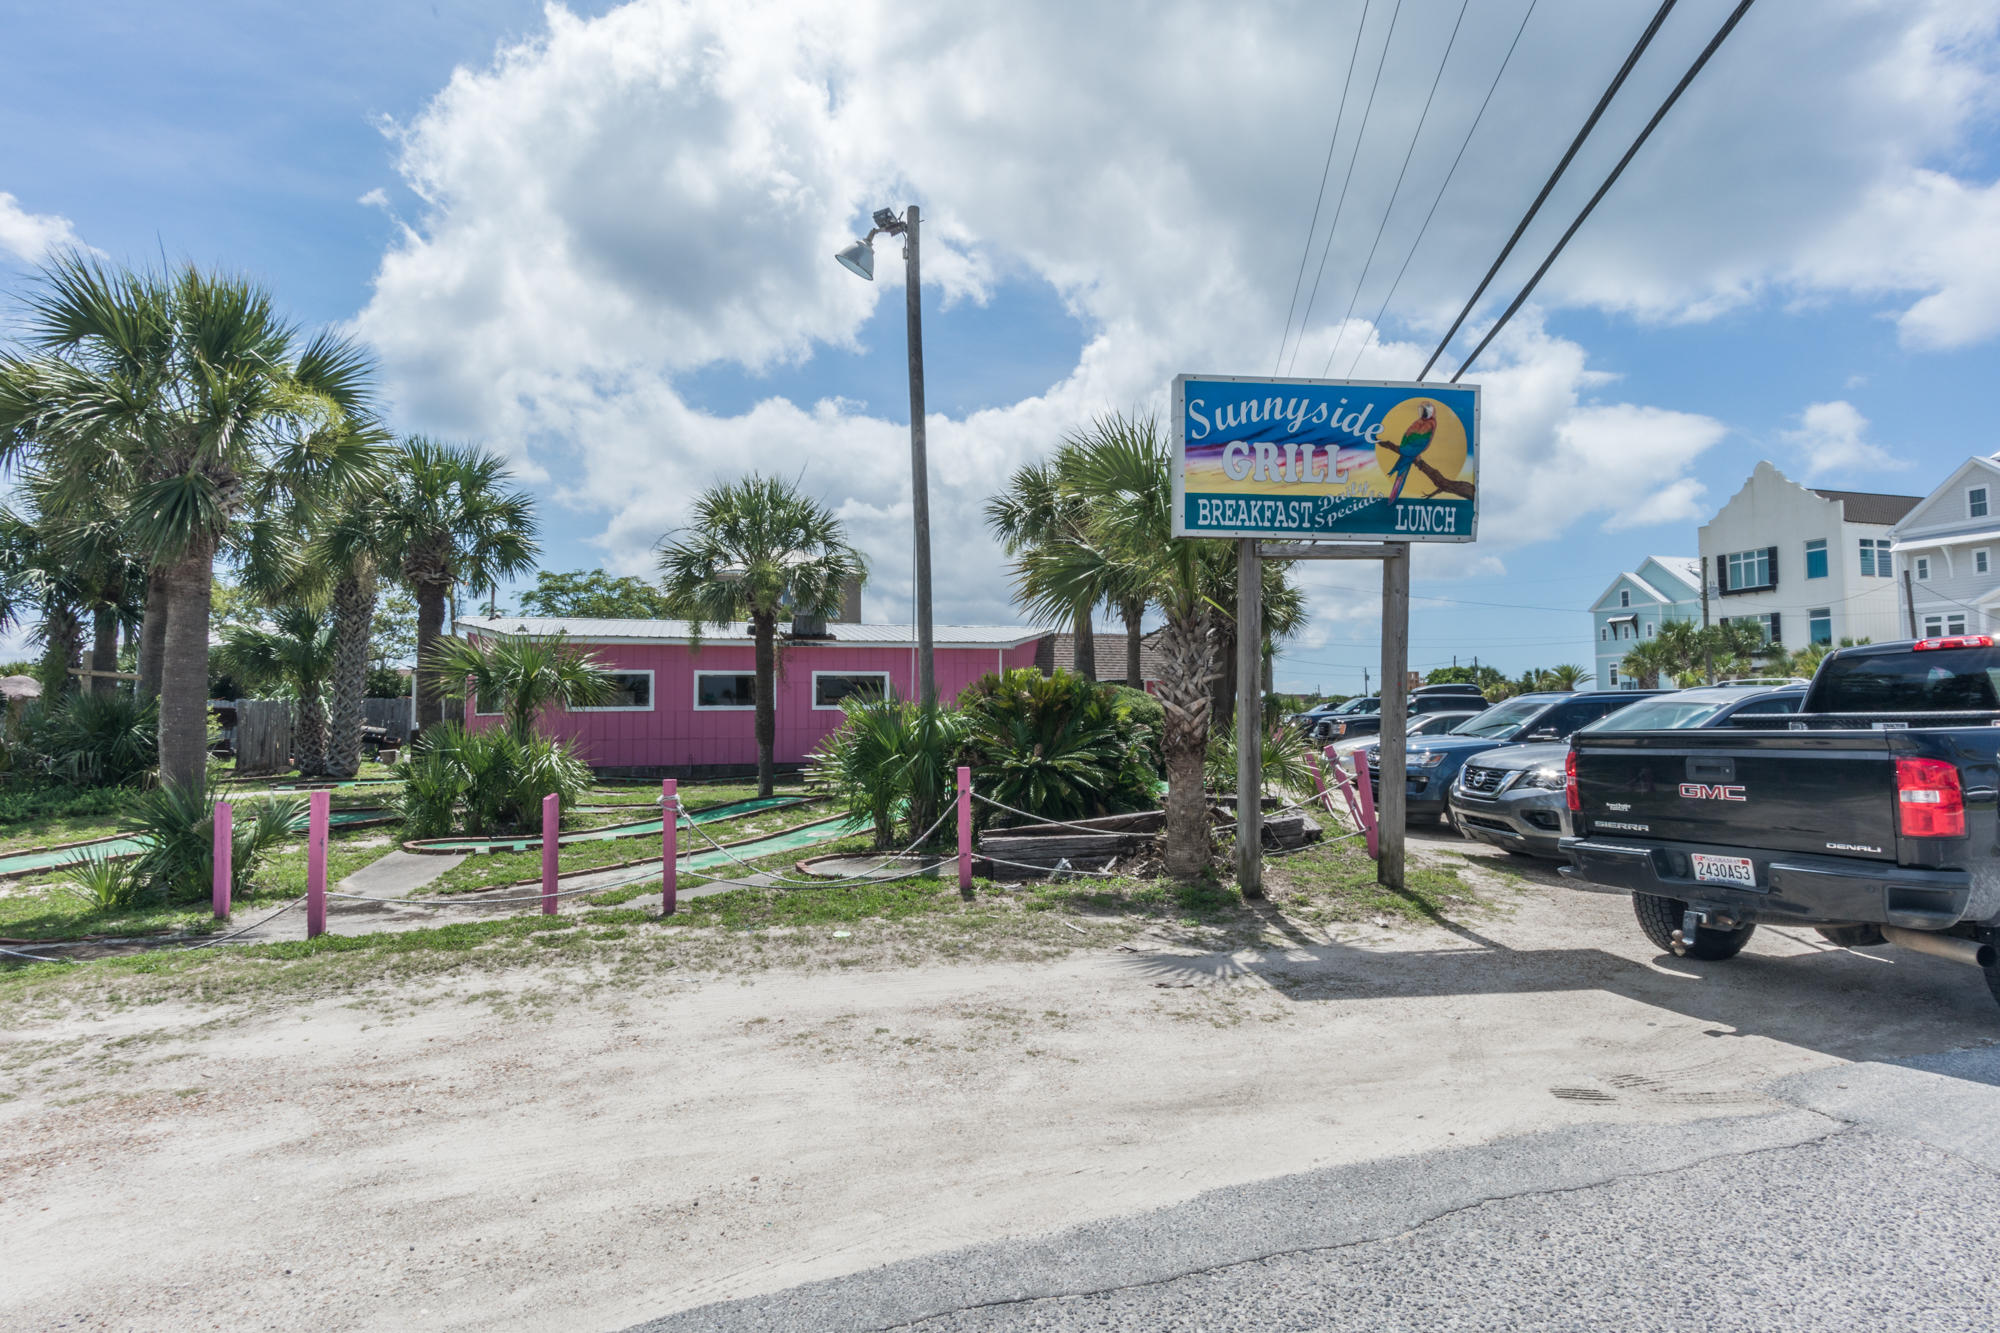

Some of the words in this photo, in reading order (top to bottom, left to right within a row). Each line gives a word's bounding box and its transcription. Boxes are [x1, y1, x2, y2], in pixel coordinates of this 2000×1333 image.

[1189, 397, 1385, 444] Sunnyside
[1222, 440, 1349, 484] GRILL
[1314, 490, 1384, 528] Specials
[1318, 481, 1369, 511] Daily
[1198, 498, 1313, 528] BREAKFAST
[1394, 504, 1456, 532] LUNCH
[1679, 783, 1746, 801] GMC
[1594, 820, 1649, 831] SIERRA
[1826, 842, 1881, 853] DENALI
